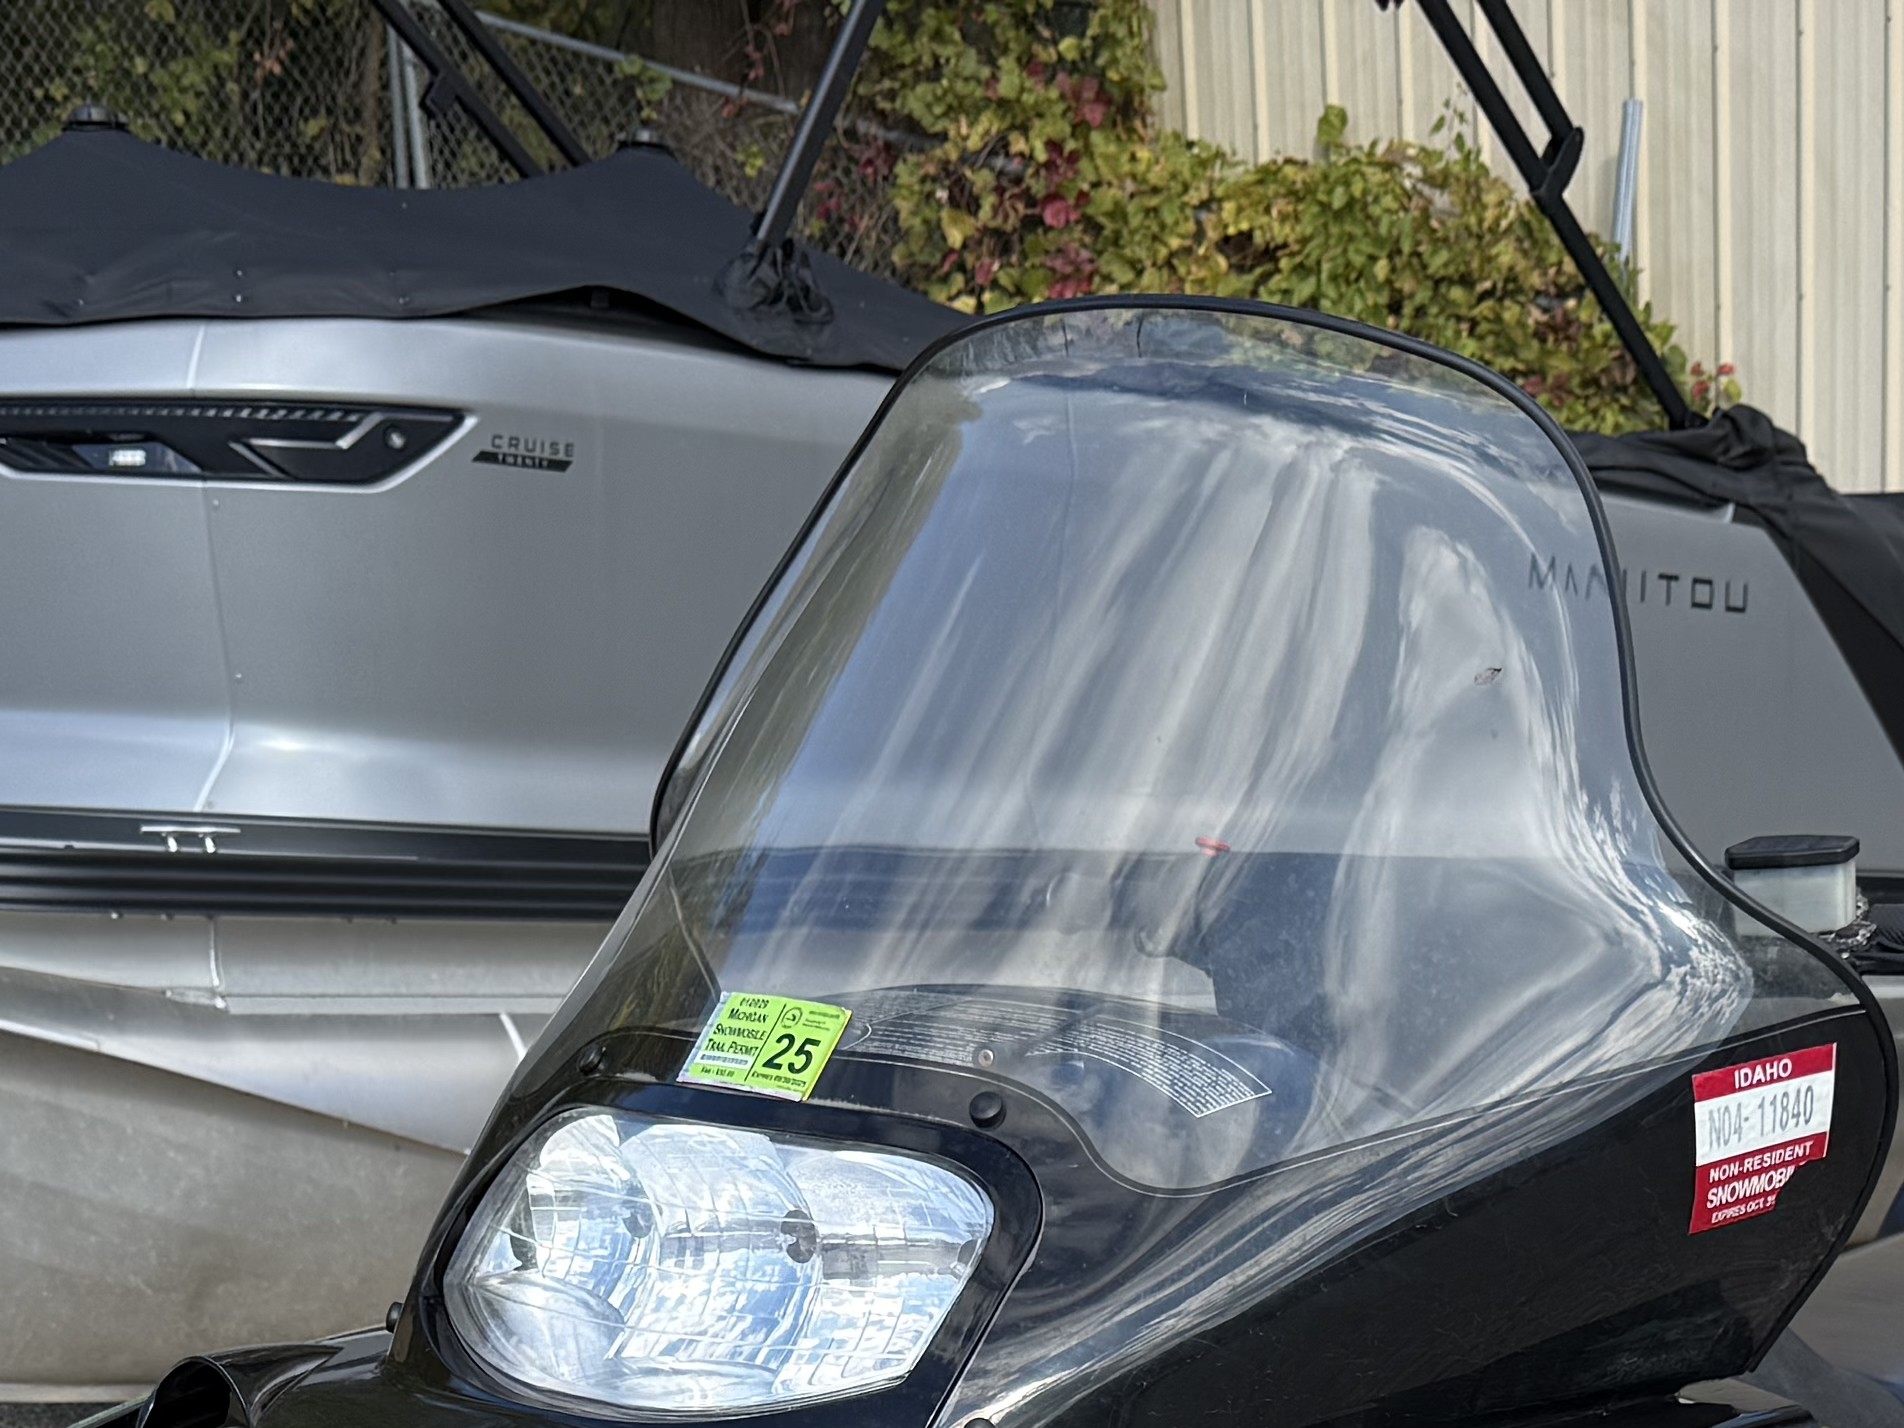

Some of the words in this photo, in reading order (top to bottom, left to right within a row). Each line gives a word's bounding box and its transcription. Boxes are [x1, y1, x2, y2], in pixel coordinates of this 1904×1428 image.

[491, 435, 574, 457] CRUISE
[1528, 553, 1749, 614] MANITOU
[762, 1033, 821, 1075] 25
[1734, 1058, 1792, 1090] IDAHO
[1709, 1140, 1814, 1183] NON-RESIDENT
